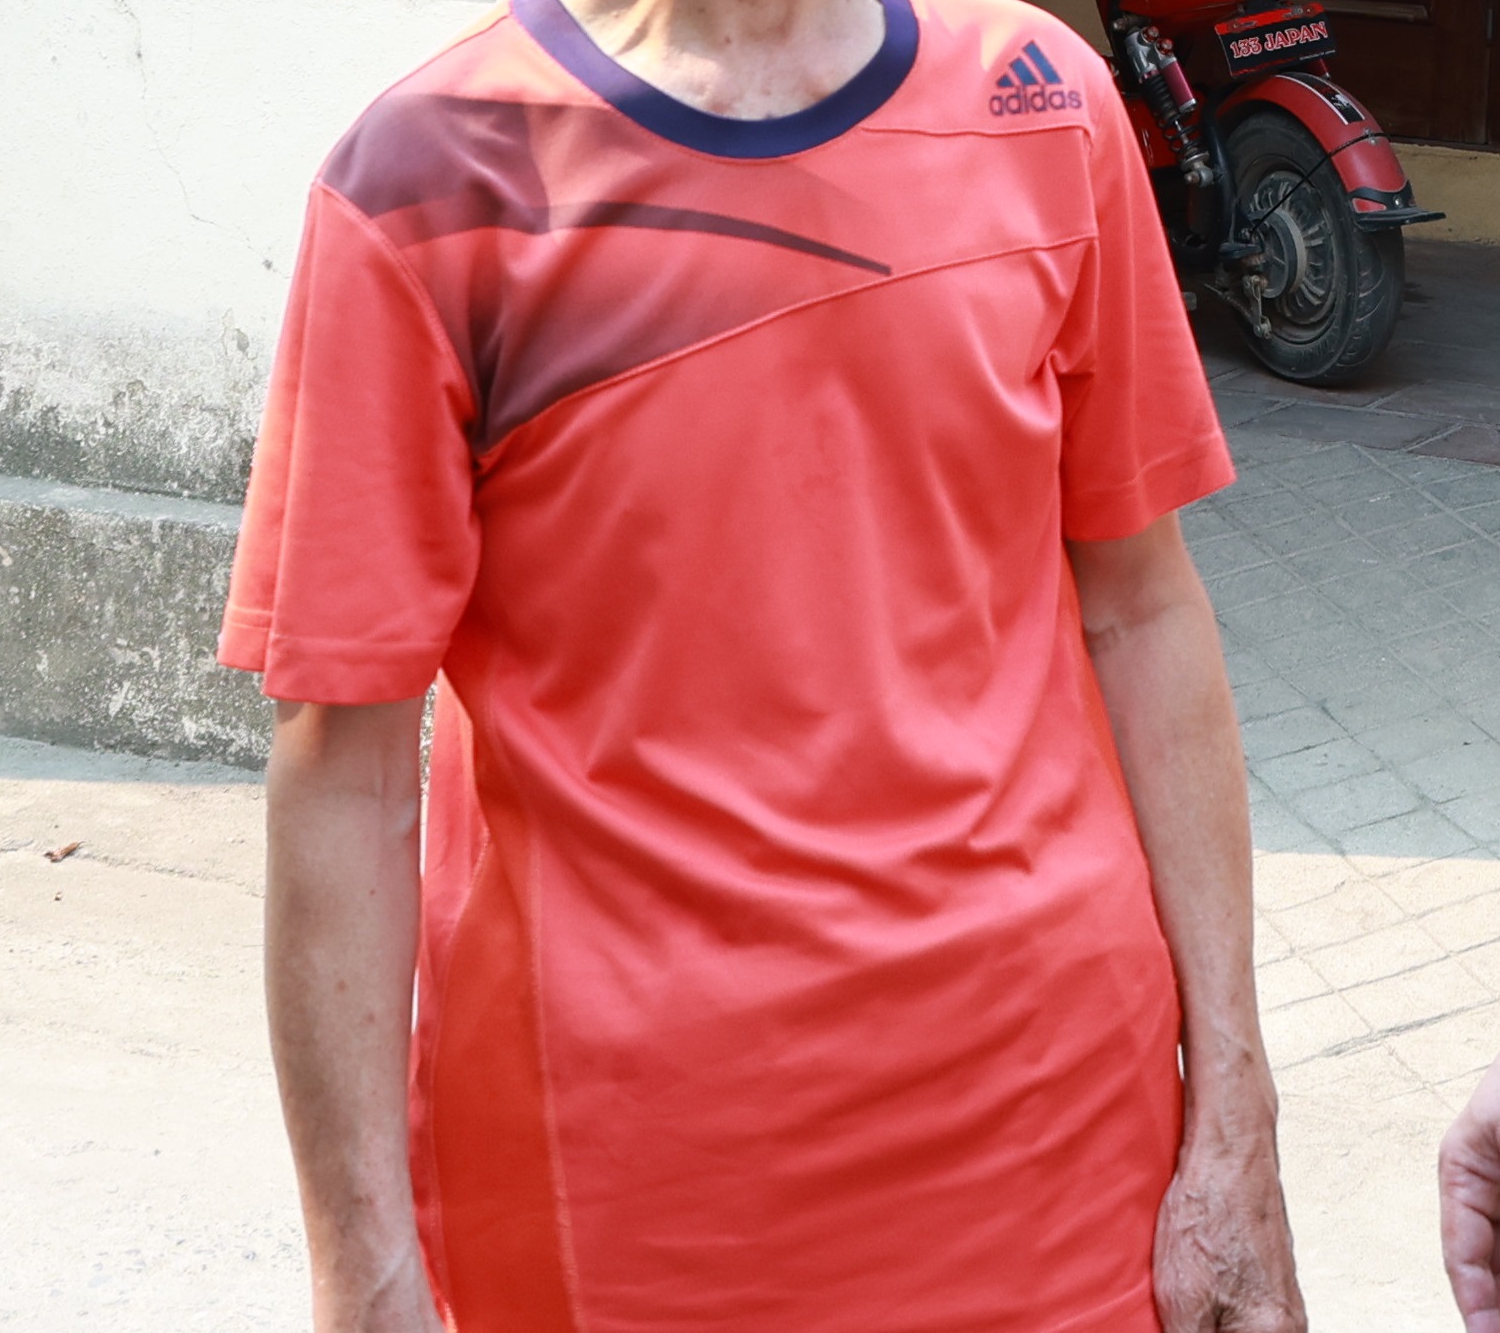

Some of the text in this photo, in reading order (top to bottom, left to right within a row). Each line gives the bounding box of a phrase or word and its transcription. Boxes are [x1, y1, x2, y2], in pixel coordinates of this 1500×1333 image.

[1230, 21, 1329, 59] 133 JAPAN
[989, 82, 1083, 117] adidas
